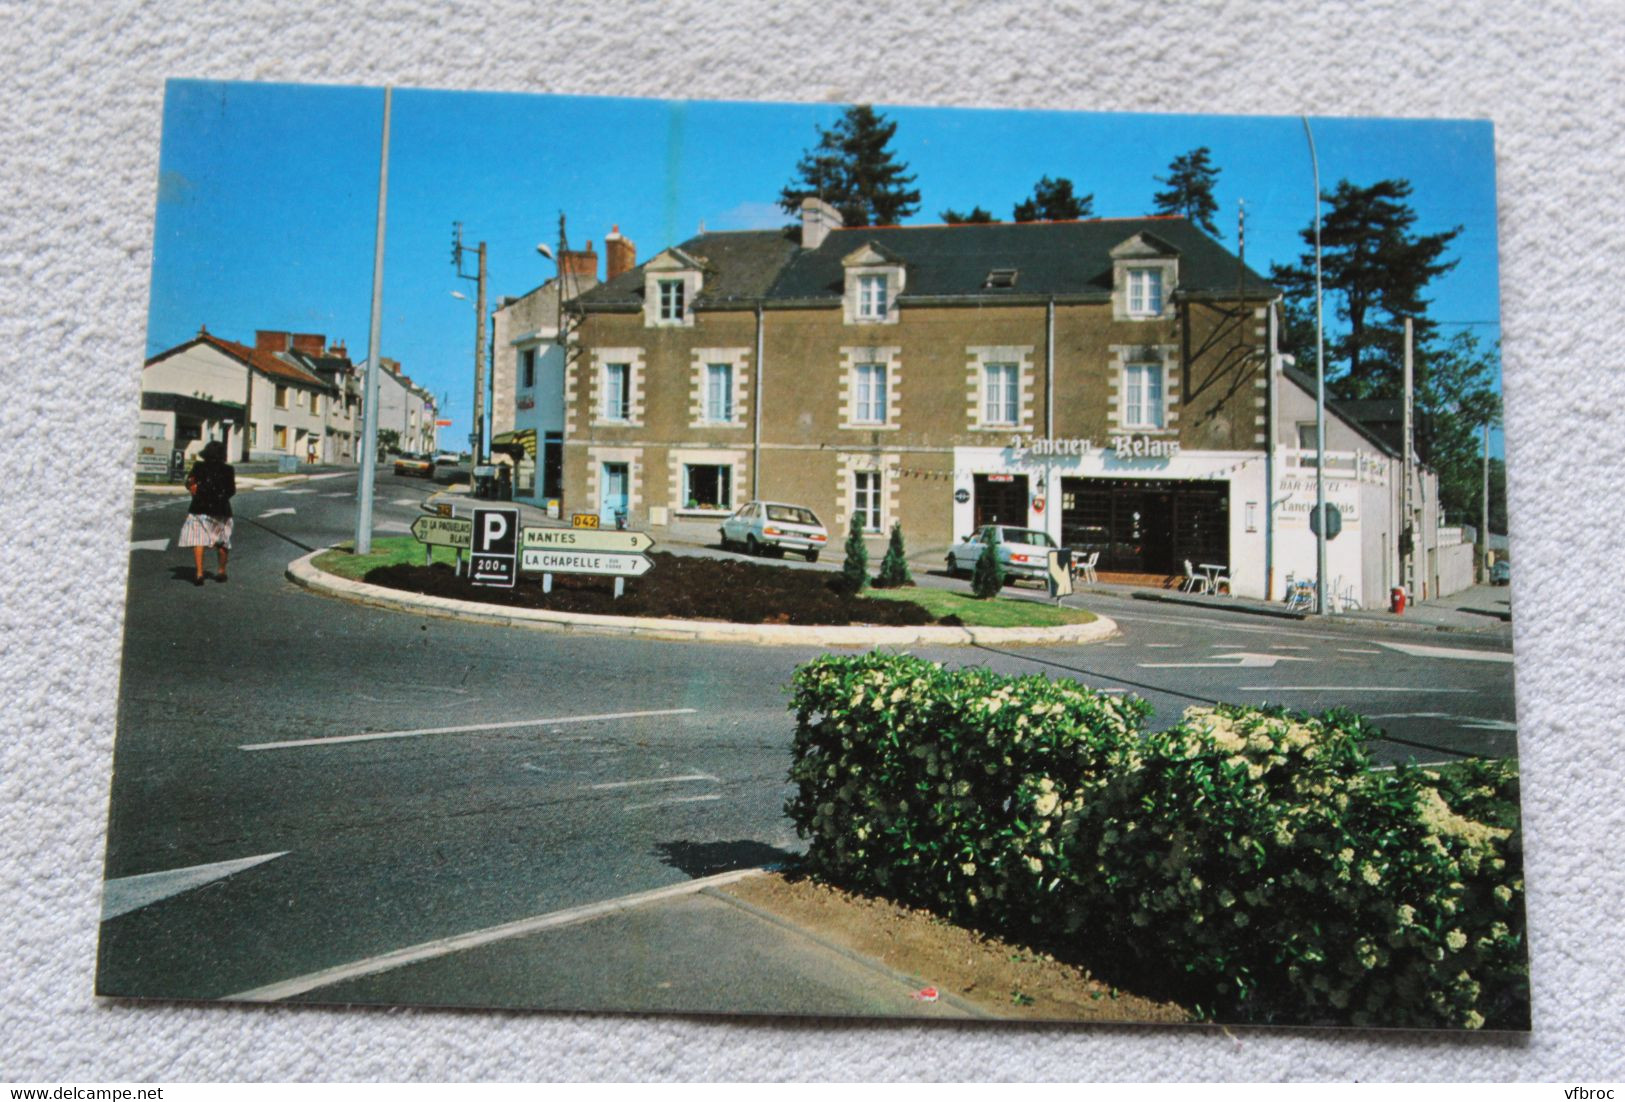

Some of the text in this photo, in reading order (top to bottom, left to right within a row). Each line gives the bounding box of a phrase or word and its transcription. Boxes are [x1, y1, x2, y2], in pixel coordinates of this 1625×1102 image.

[1111, 434, 1181, 458] Relais
[573, 516, 597, 527] D42
[482, 513, 507, 550] P
[527, 532, 638, 547] NANTES 9
[478, 560, 499, 571] 200
[525, 555, 539, 565] LA
[543, 556, 600, 569] CHAPELLE
[631, 560, 637, 569] 7
